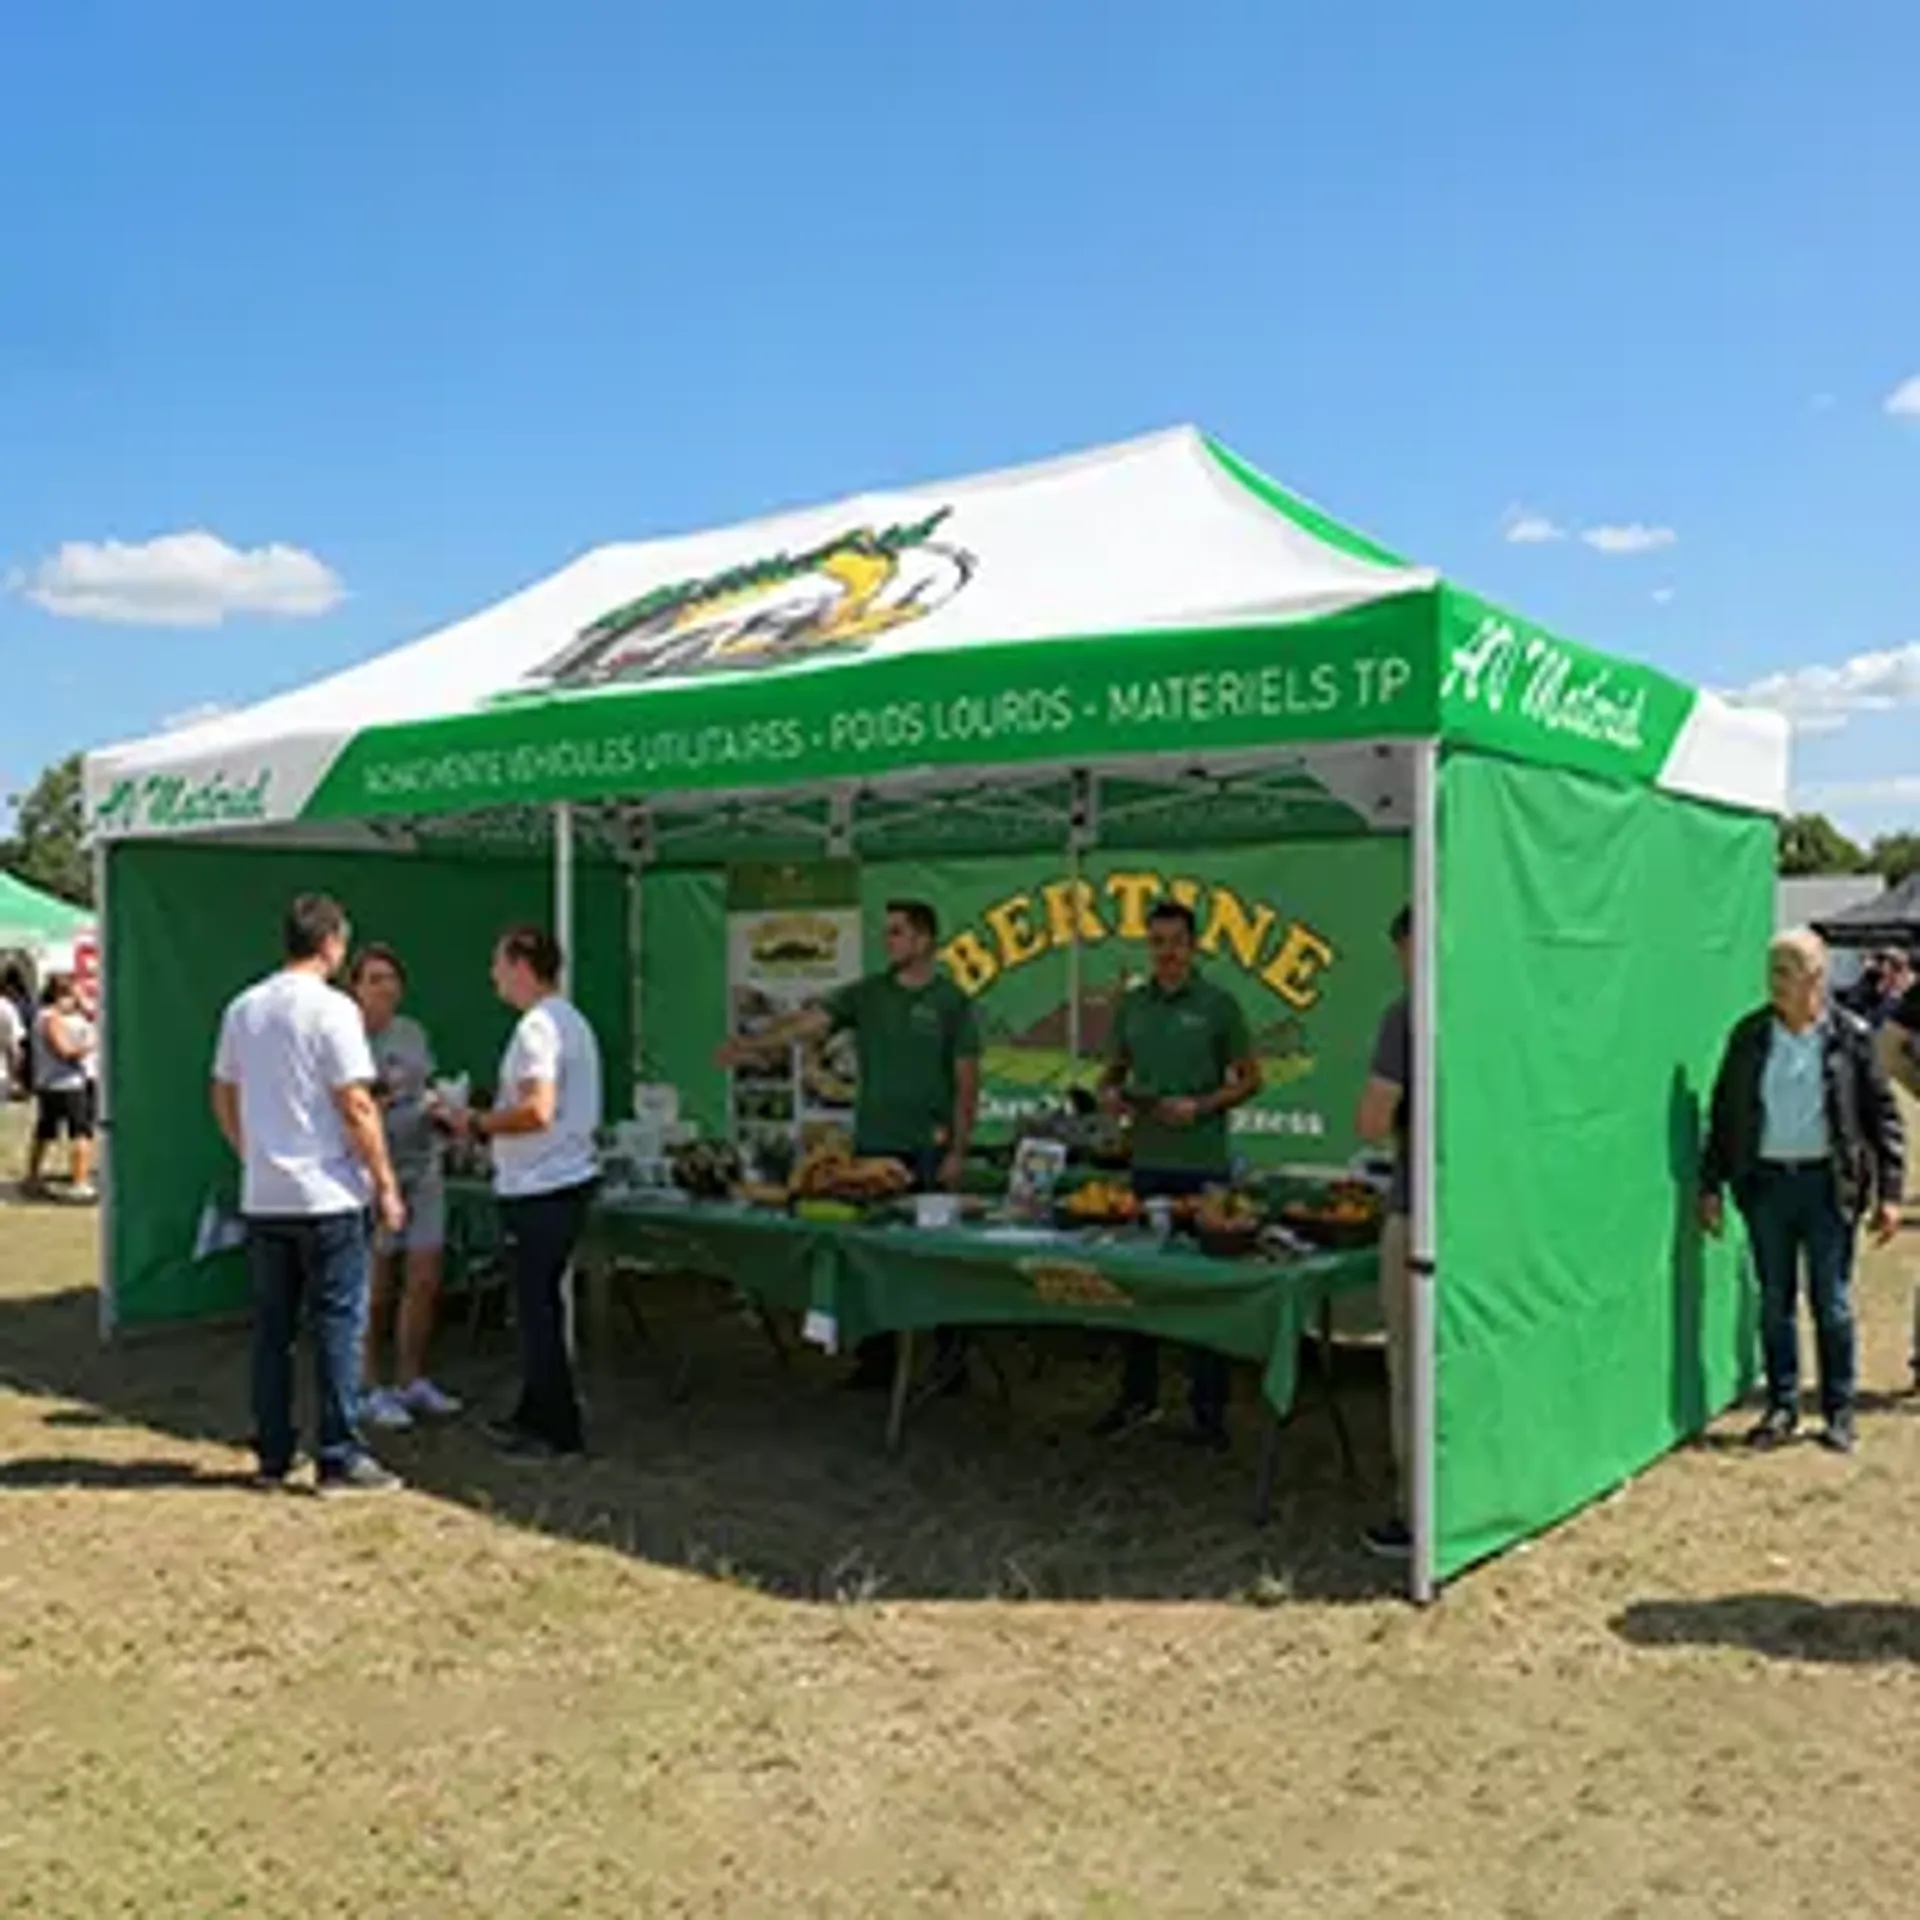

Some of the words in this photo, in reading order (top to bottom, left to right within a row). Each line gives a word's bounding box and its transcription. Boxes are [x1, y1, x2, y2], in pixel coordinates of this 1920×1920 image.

[830, 710, 924, 751] POIDS
[934, 688, 1072, 742] LOURDS
[1107, 663, 1340, 726] MATERIELS
[1354, 656, 1412, 704] TP
